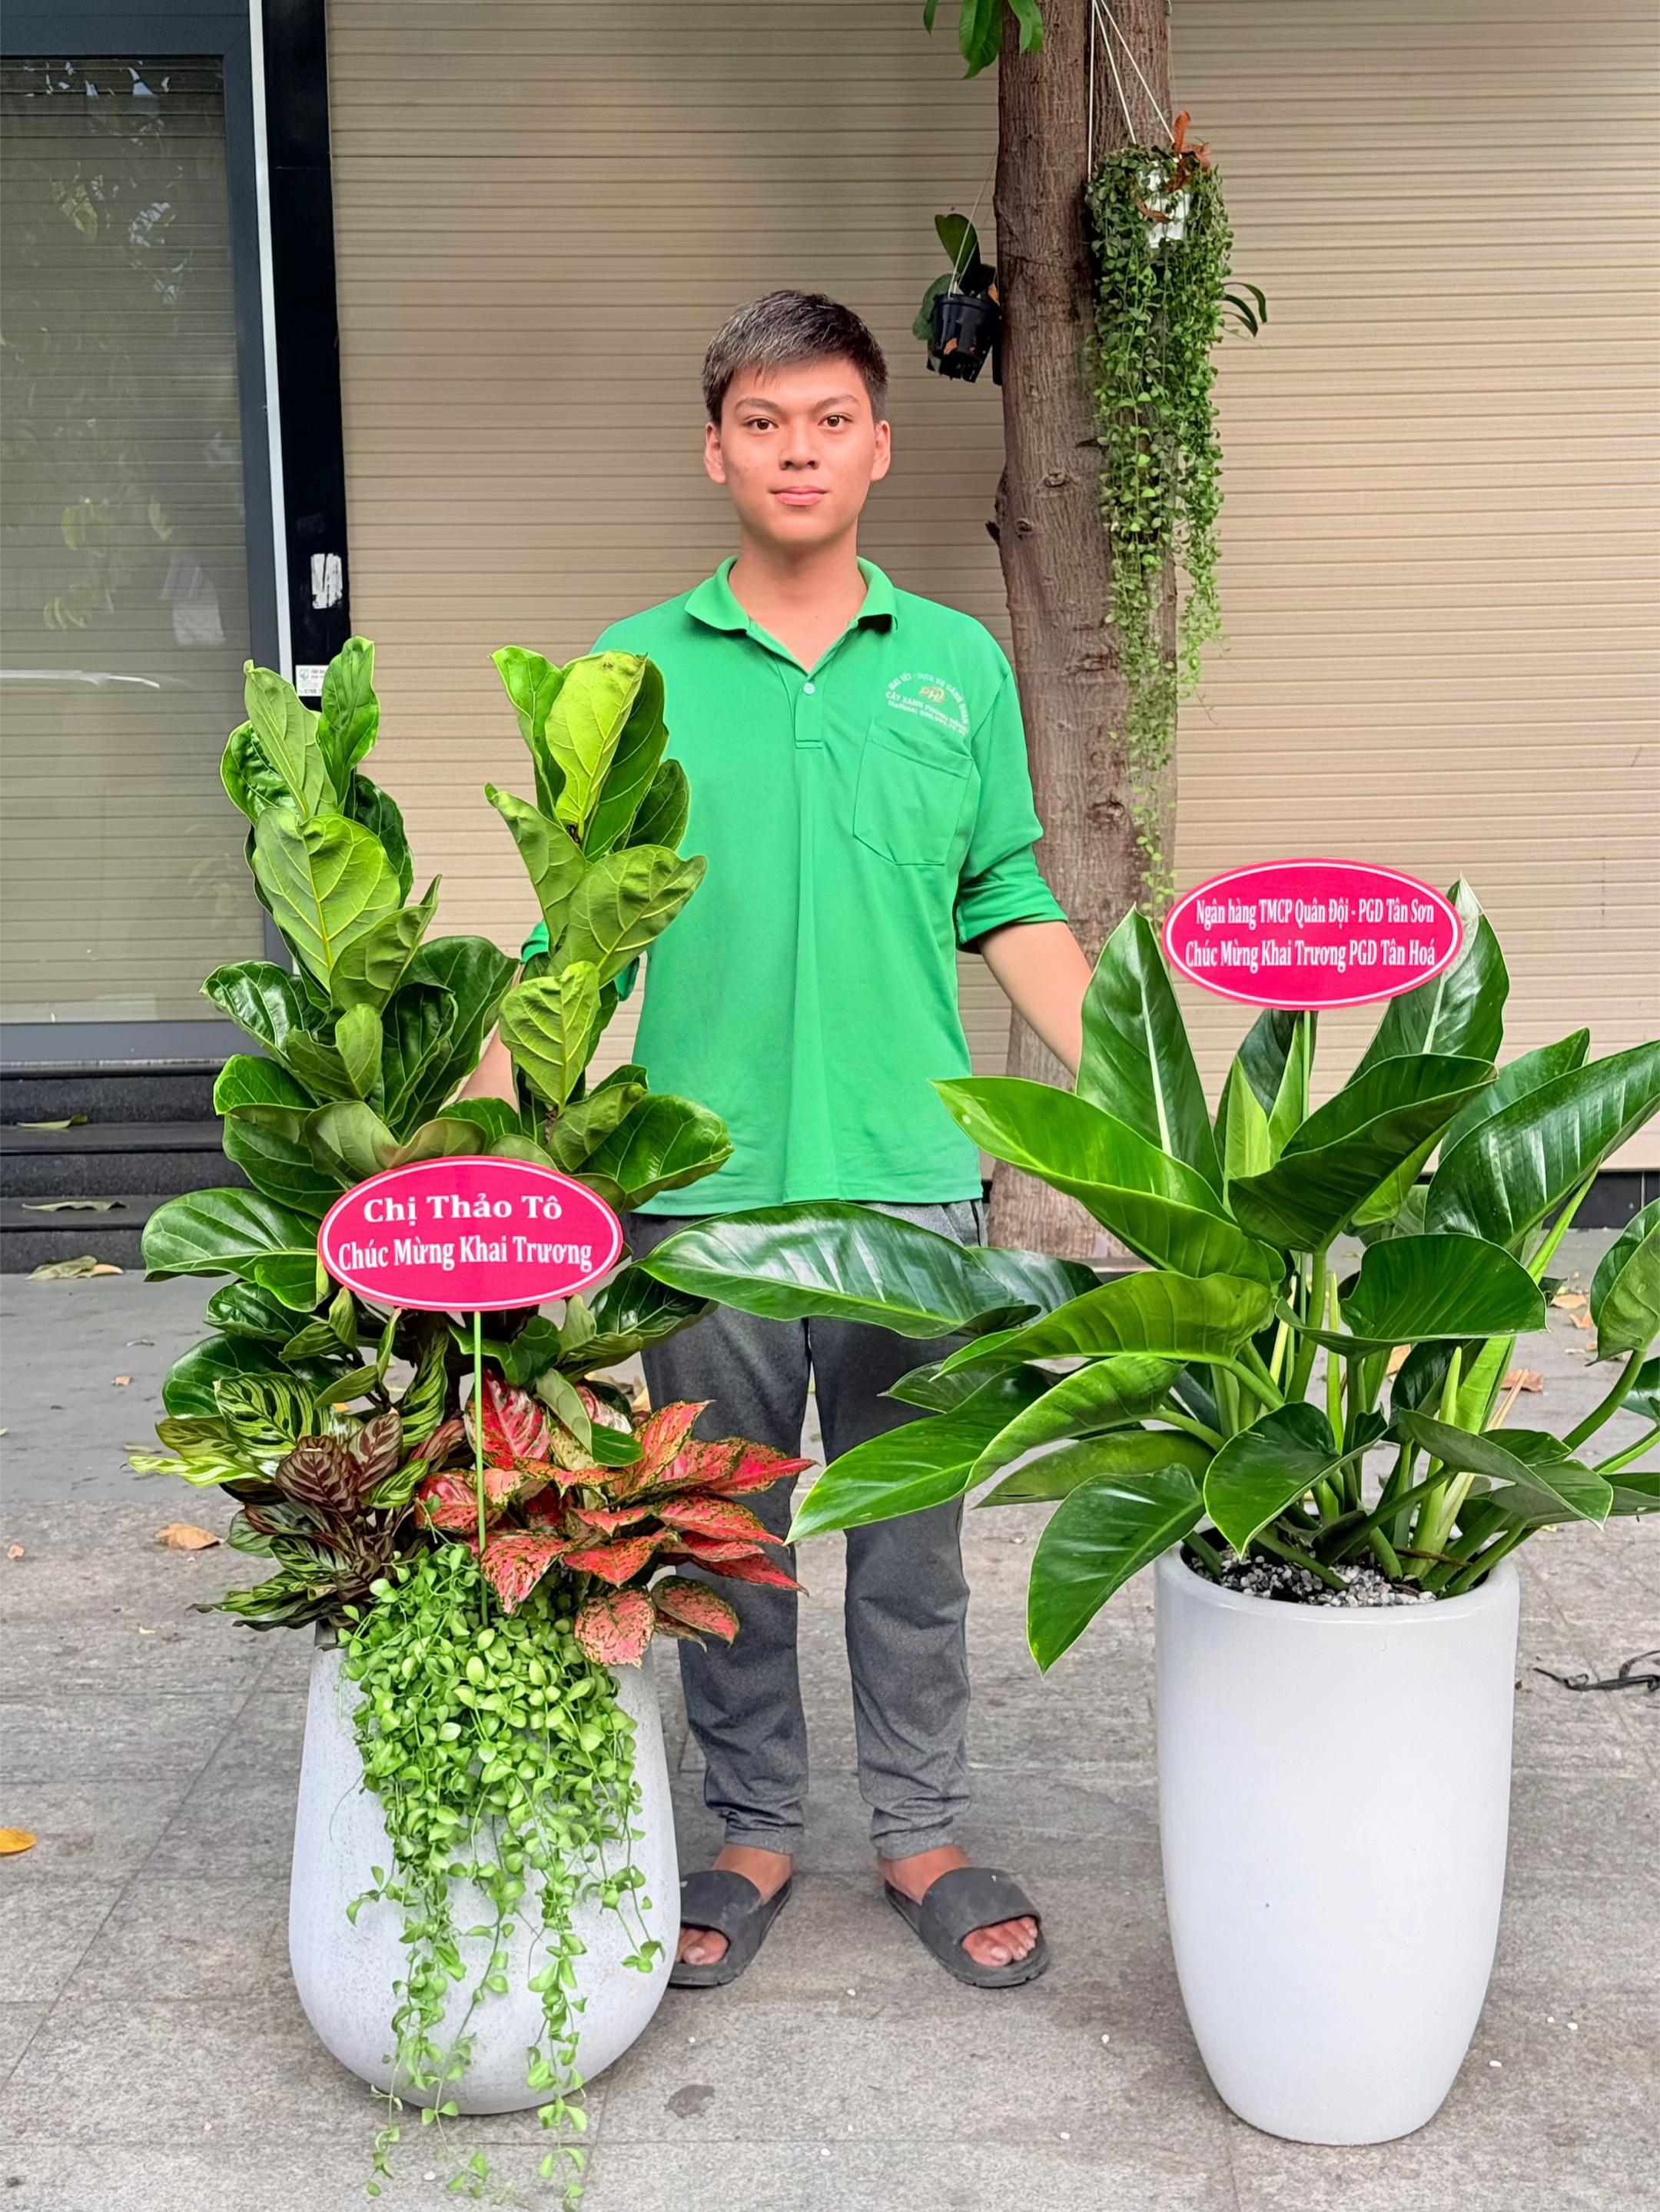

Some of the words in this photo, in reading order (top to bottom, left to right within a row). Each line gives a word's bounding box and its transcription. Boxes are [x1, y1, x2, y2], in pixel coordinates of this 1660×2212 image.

[1197, 898, 1225, 931] Ngân
[1228, 898, 1257, 930] hàng
[1259, 898, 1293, 923] TMCP
[1295, 898, 1326, 928] Quân
[1329, 898, 1349, 928] Đội
[1359, 898, 1383, 923] PGD
[1386, 898, 1408, 922] Tân
[1411, 898, 1434, 923] Sơn
[1186, 940, 1217, 968] Chúc
[1220, 939, 1258, 974] Mừng
[1261, 939, 1291, 965] Khai
[1295, 940, 1346, 973] Trương
[1350, 940, 1377, 965] PGD
[1380, 938, 1405, 965] Tân
[1409, 938, 1435, 966] Hoá
[364, 1197, 417, 1226] Chị
[427, 1193, 512, 1218] Thảo
[521, 1195, 562, 1219] Tô
[338, 1239, 388, 1272] Chúc
[393, 1237, 455, 1270] Mừng
[460, 1235, 507, 1263] Khai
[513, 1236, 593, 1273] Trương
